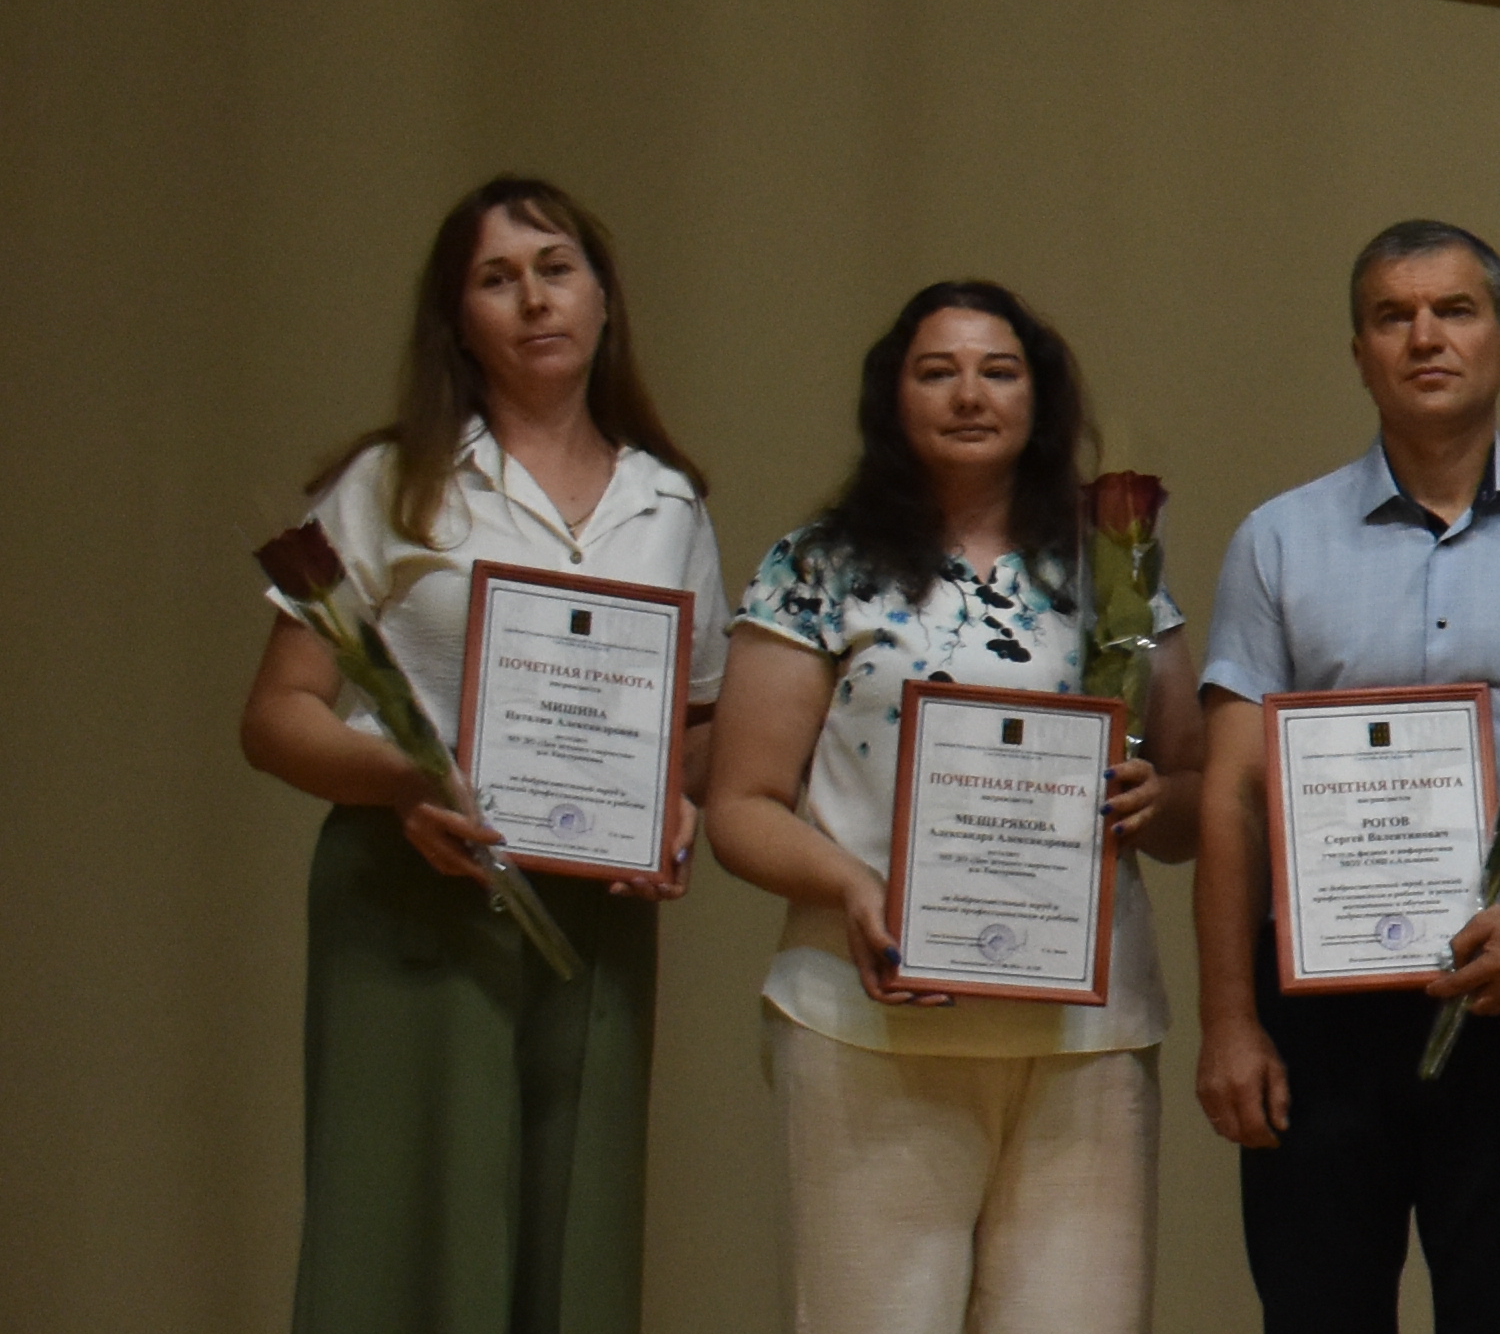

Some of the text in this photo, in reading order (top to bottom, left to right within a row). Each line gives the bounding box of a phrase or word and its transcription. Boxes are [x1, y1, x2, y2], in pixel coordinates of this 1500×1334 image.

[497, 655, 654, 690] ПОЧЕТНАЯ ГРАМОТА
[929, 771, 1087, 797] ПОЧЕТНАЯ ГРАМОТА
[1301, 775, 1464, 795] ПОЧЕТНАЯ ГРАМОТА
[1361, 815, 1410, 828] РОГОВ
